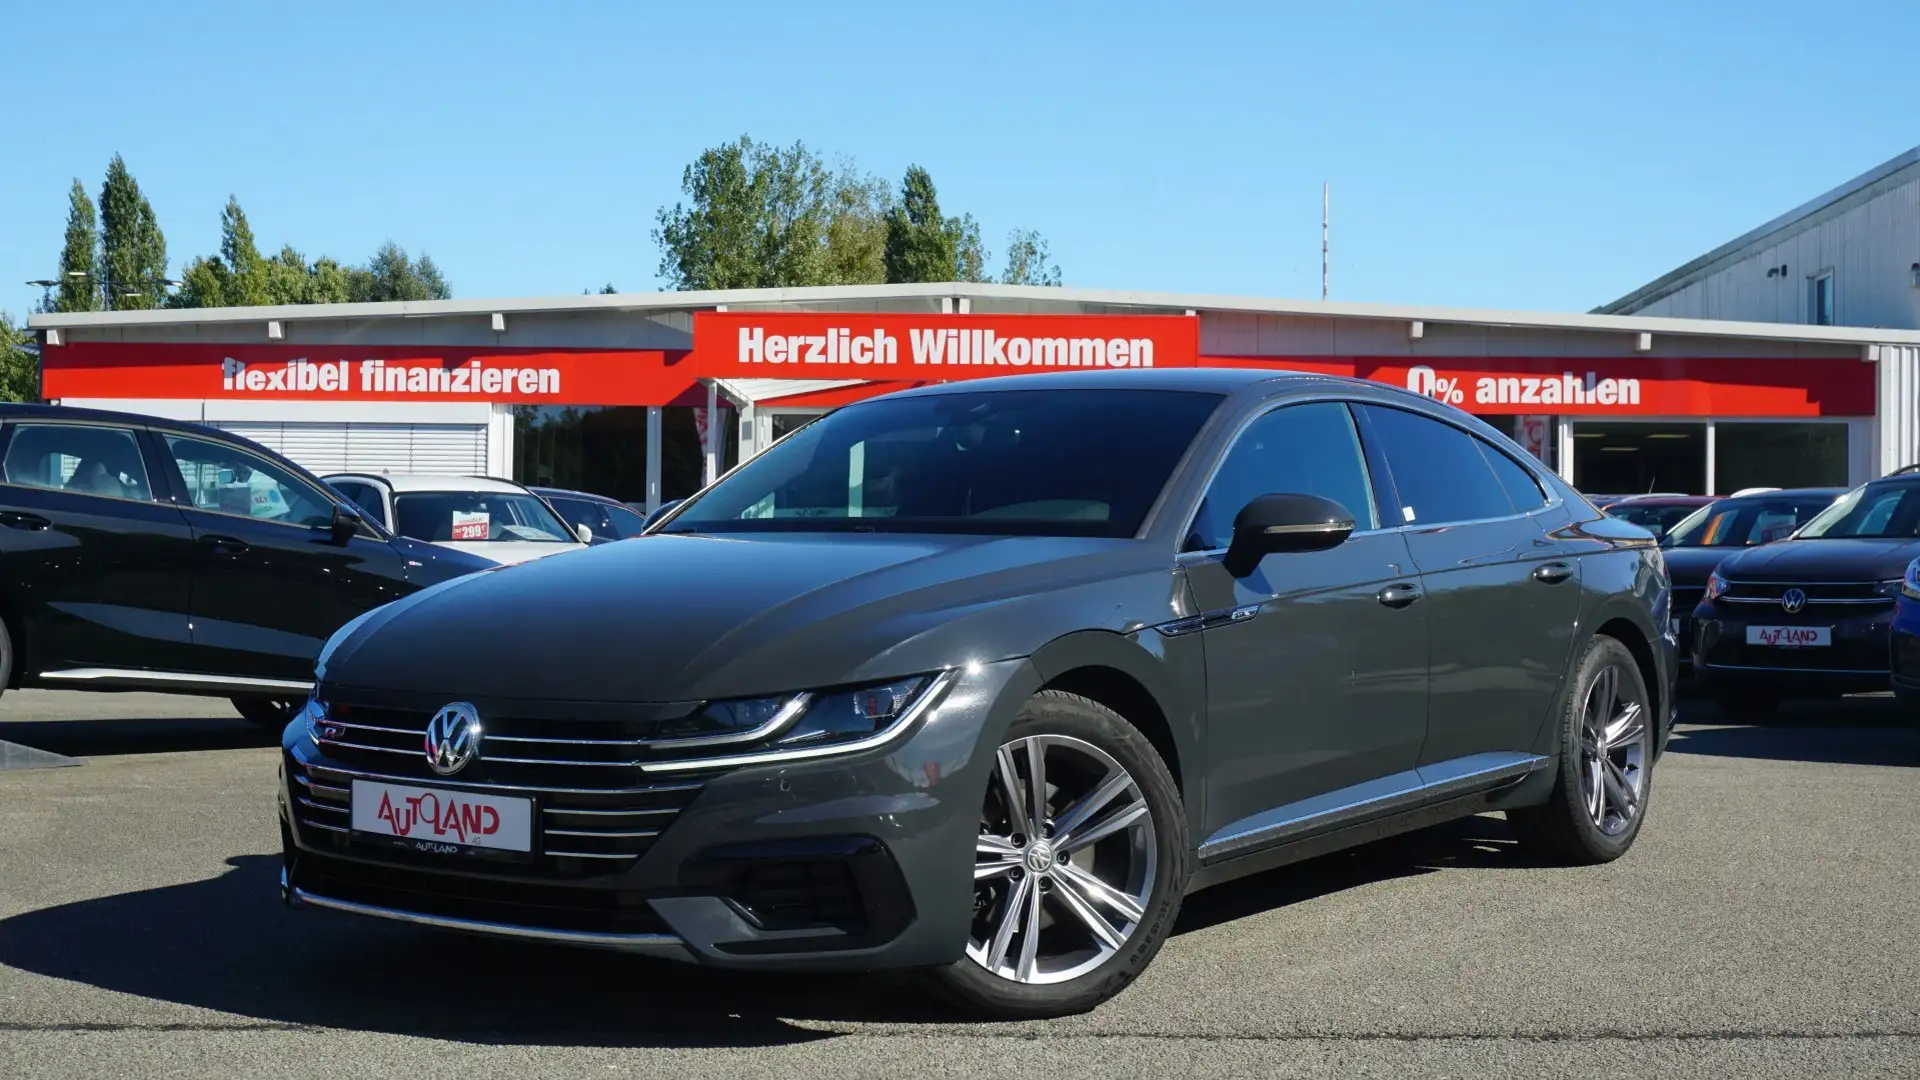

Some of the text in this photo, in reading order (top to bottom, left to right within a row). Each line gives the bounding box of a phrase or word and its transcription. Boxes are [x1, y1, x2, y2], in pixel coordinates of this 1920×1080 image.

[738, 327, 1154, 368] Herzlich Willkommen
[222, 356, 560, 393] flexibel finanzieren
[1407, 365, 1641, 405] 0% anzahlen
[1759, 627, 1818, 645] AUTOLAND
[377, 789, 500, 843] AUTOLAND
[415, 841, 458, 854] AUTOLAND
